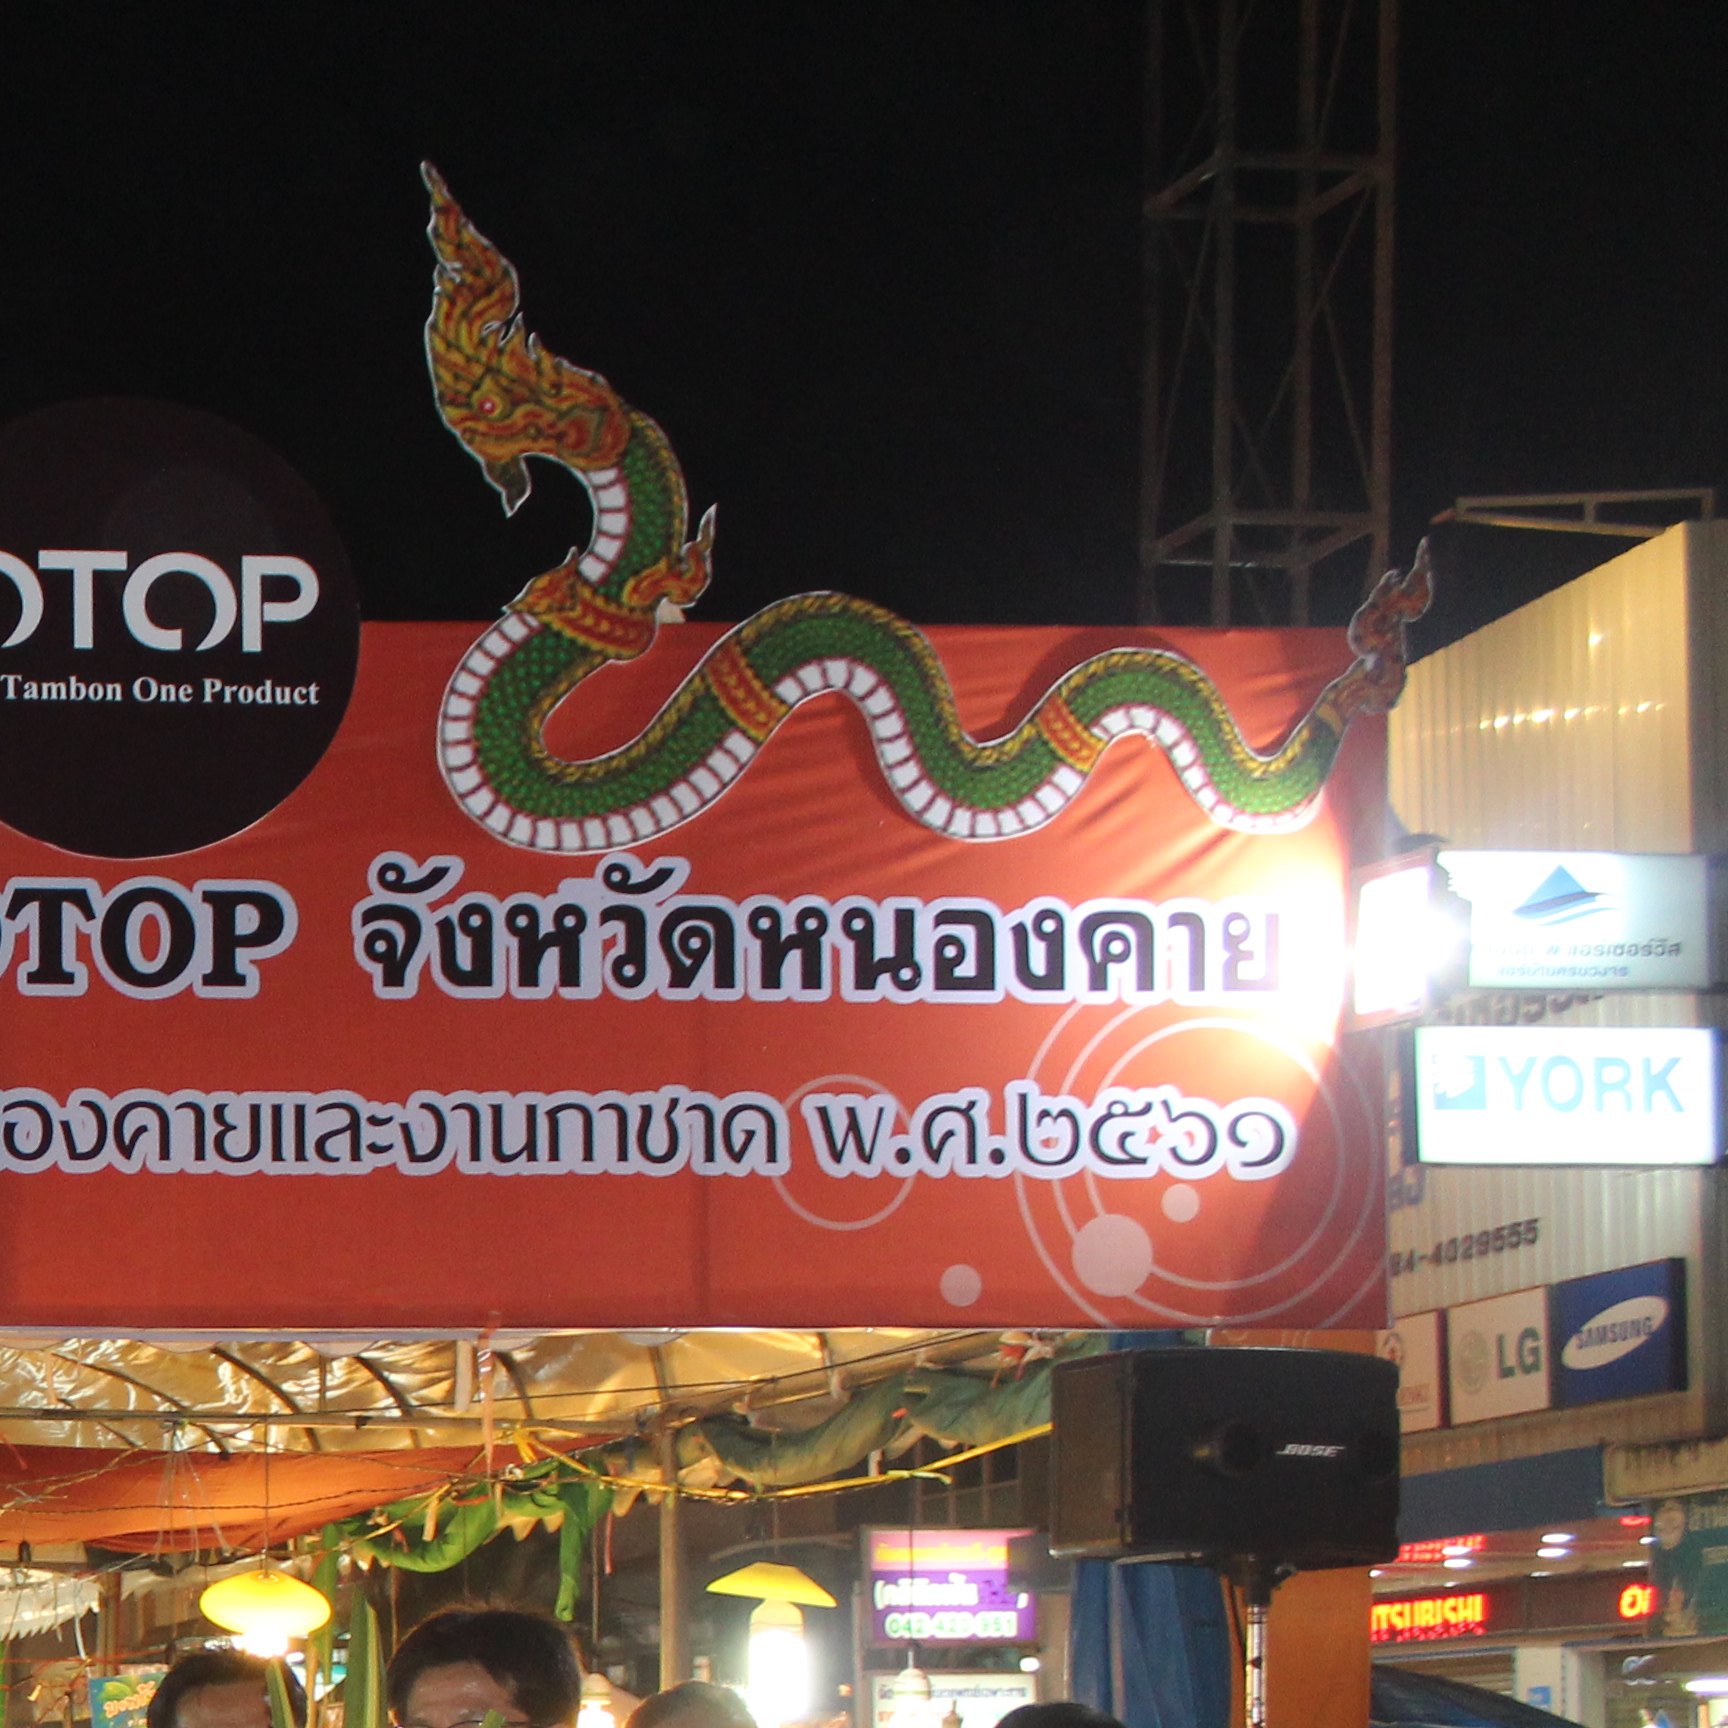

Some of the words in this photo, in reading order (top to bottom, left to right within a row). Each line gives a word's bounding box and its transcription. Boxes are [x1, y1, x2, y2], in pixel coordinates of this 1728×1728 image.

[0, 674, 123, 702] Tambon
[132, 676, 194, 703] One
[203, 678, 320, 706] Product
[361, 862, 1281, 993] จังหวัดหนองคาย
[1495, 1054, 1686, 1113] YORK
[1575, 1315, 1655, 1351] SAMSUNG
[1496, 1326, 1543, 1380] LG
[1275, 1443, 1346, 1458] BOSE
[1370, 1592, 1488, 1631] ITSUBISHI
